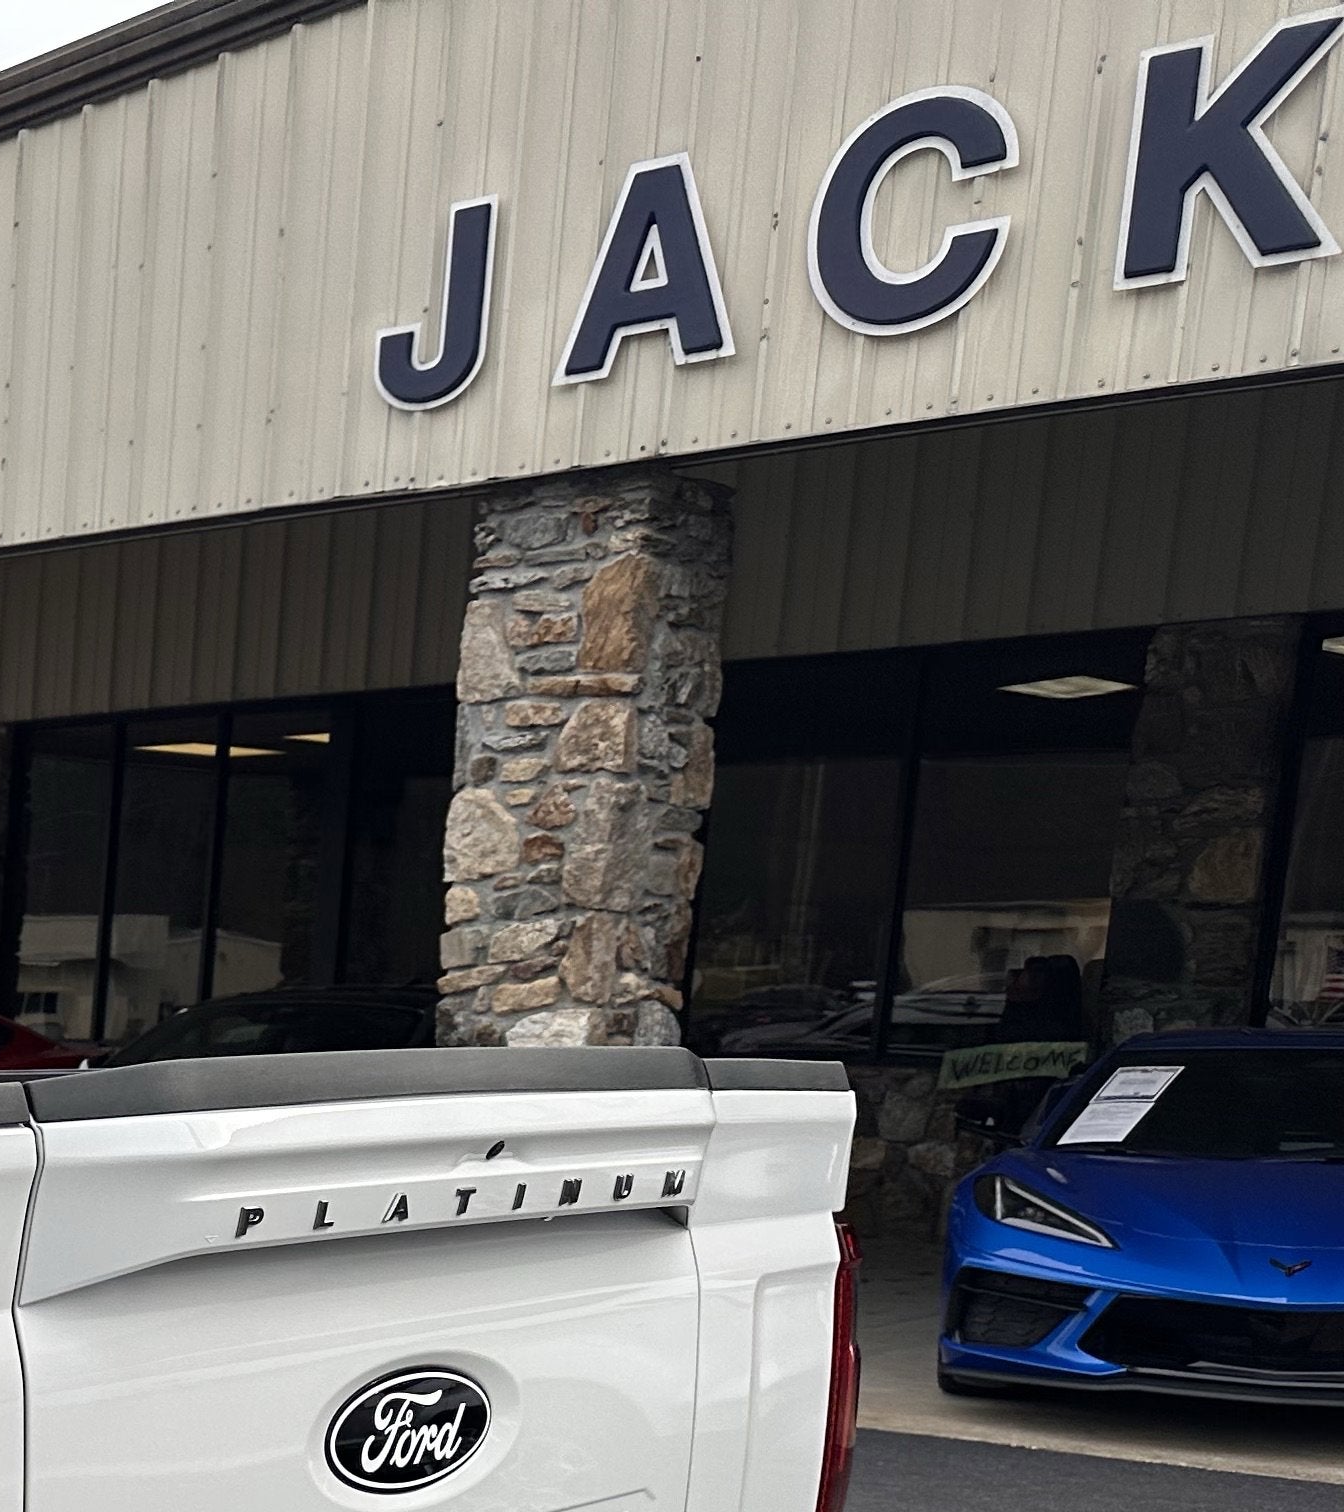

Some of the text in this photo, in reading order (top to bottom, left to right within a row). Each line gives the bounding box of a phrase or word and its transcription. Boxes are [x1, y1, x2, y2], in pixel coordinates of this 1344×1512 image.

[951, 1051, 1082, 1079] WELCOME
[234, 1168, 686, 1237] PLATINUM
[360, 1391, 464, 1474] Ford
